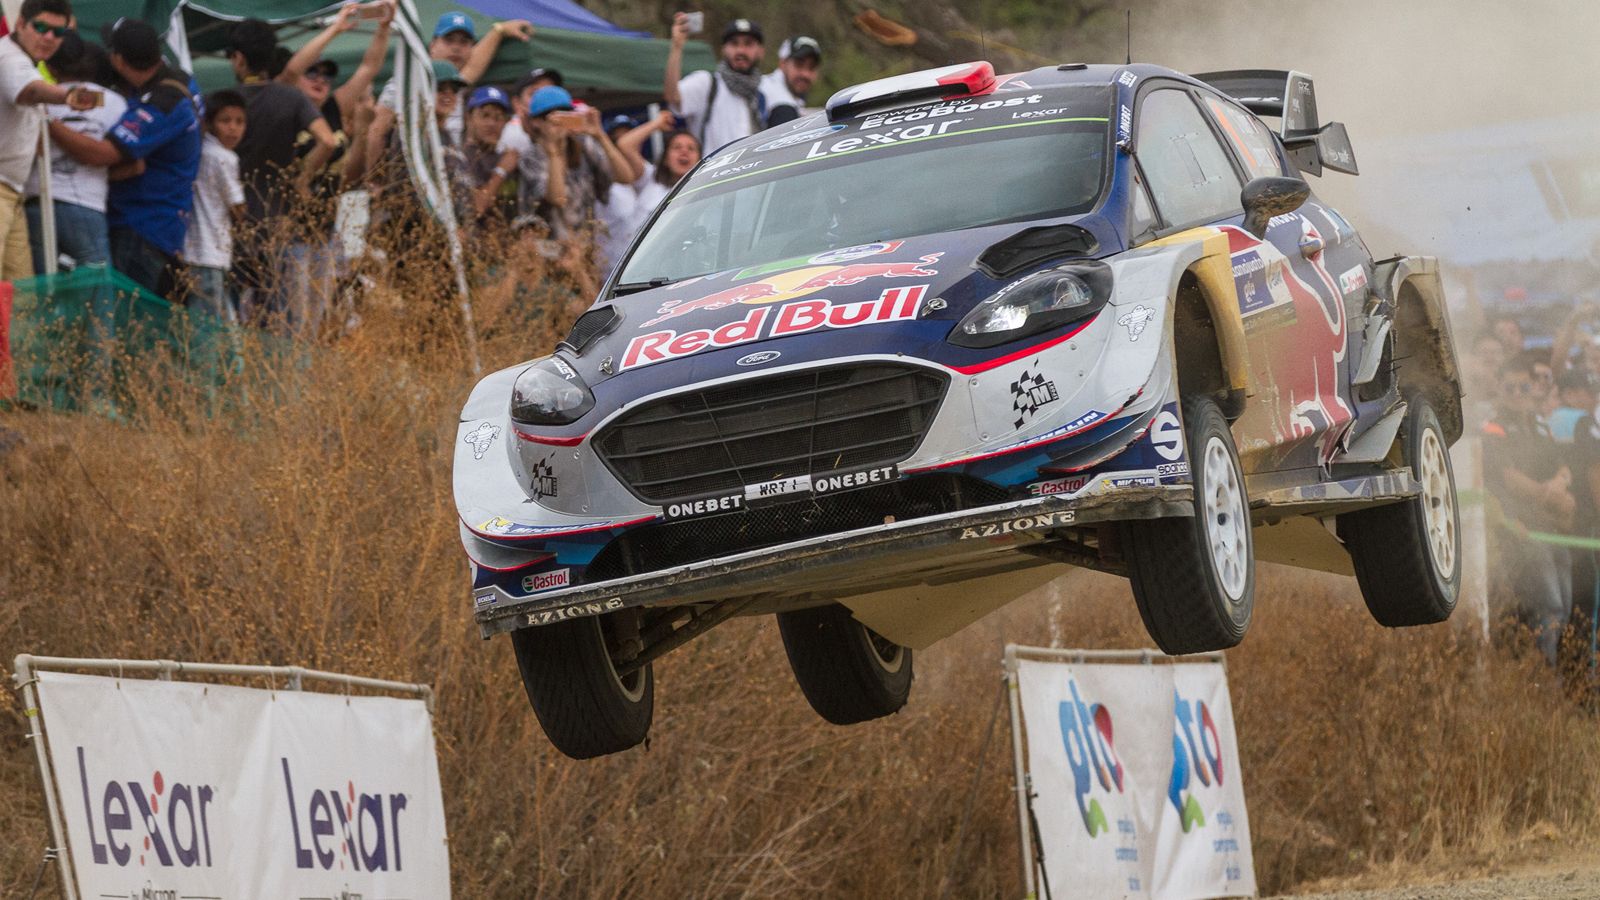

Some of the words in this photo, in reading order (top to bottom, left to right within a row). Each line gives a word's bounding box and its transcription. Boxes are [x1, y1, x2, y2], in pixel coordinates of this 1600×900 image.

[859, 94, 1043, 131] EcoBoost
[865, 98, 948, 121] Powered
[950, 98, 973, 109] by
[1012, 106, 1068, 120] Lexar
[806, 118, 964, 160] Lexar
[711, 160, 763, 178] Lexar
[620, 307, 770, 370] Red
[771, 285, 928, 336] Bull
[759, 481, 788, 496] WRT
[815, 467, 893, 492] ONEBET
[1041, 477, 1086, 495] Castrol
[668, 495, 743, 518] ONEBET
[959, 511, 1076, 540] AZIONE
[533, 571, 568, 590] Castrol
[527, 597, 625, 626] AZIONE
[76, 746, 214, 867] Lexar
[281, 757, 408, 872] Lexar
